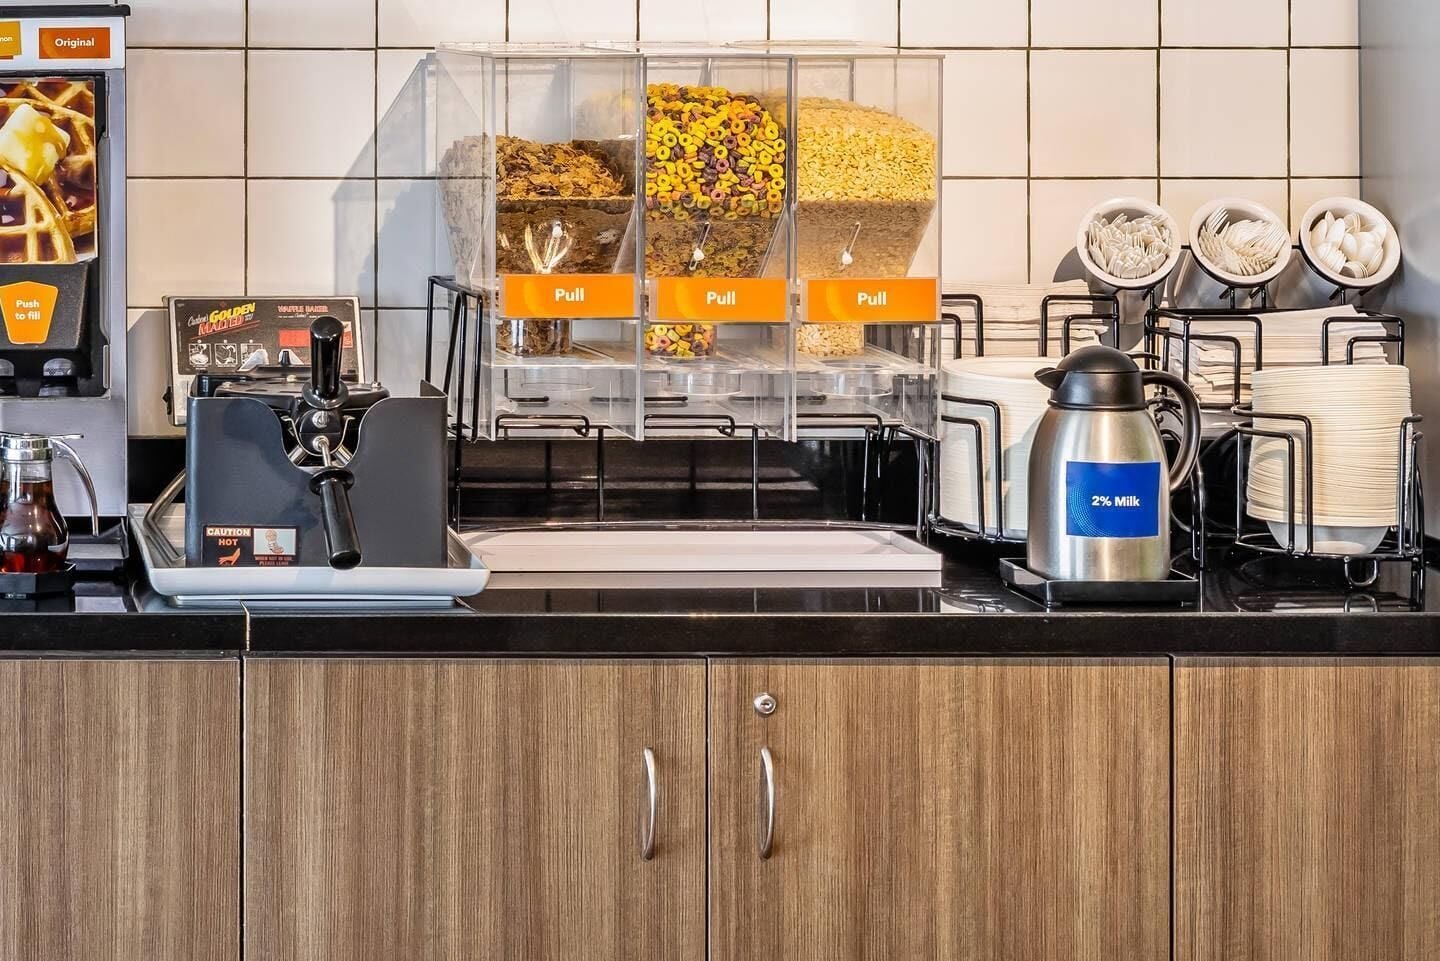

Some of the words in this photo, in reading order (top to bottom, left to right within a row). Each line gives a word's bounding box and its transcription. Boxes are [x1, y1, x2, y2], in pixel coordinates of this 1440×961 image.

[54, 37, 95, 49] Original
[555, 287, 585, 302] Pull
[706, 291, 736, 306] Pull
[857, 291, 887, 306] Pull
[16, 299, 40, 308] Push
[15, 312, 26, 320] to
[27, 310, 41, 320] fill
[209, 302, 256, 324] GOLDEN
[1091, 495, 1112, 507] 2%
[1114, 495, 1140, 507] Milk
[207, 527, 251, 536] CAUTION
[218, 538, 239, 546] HOT
